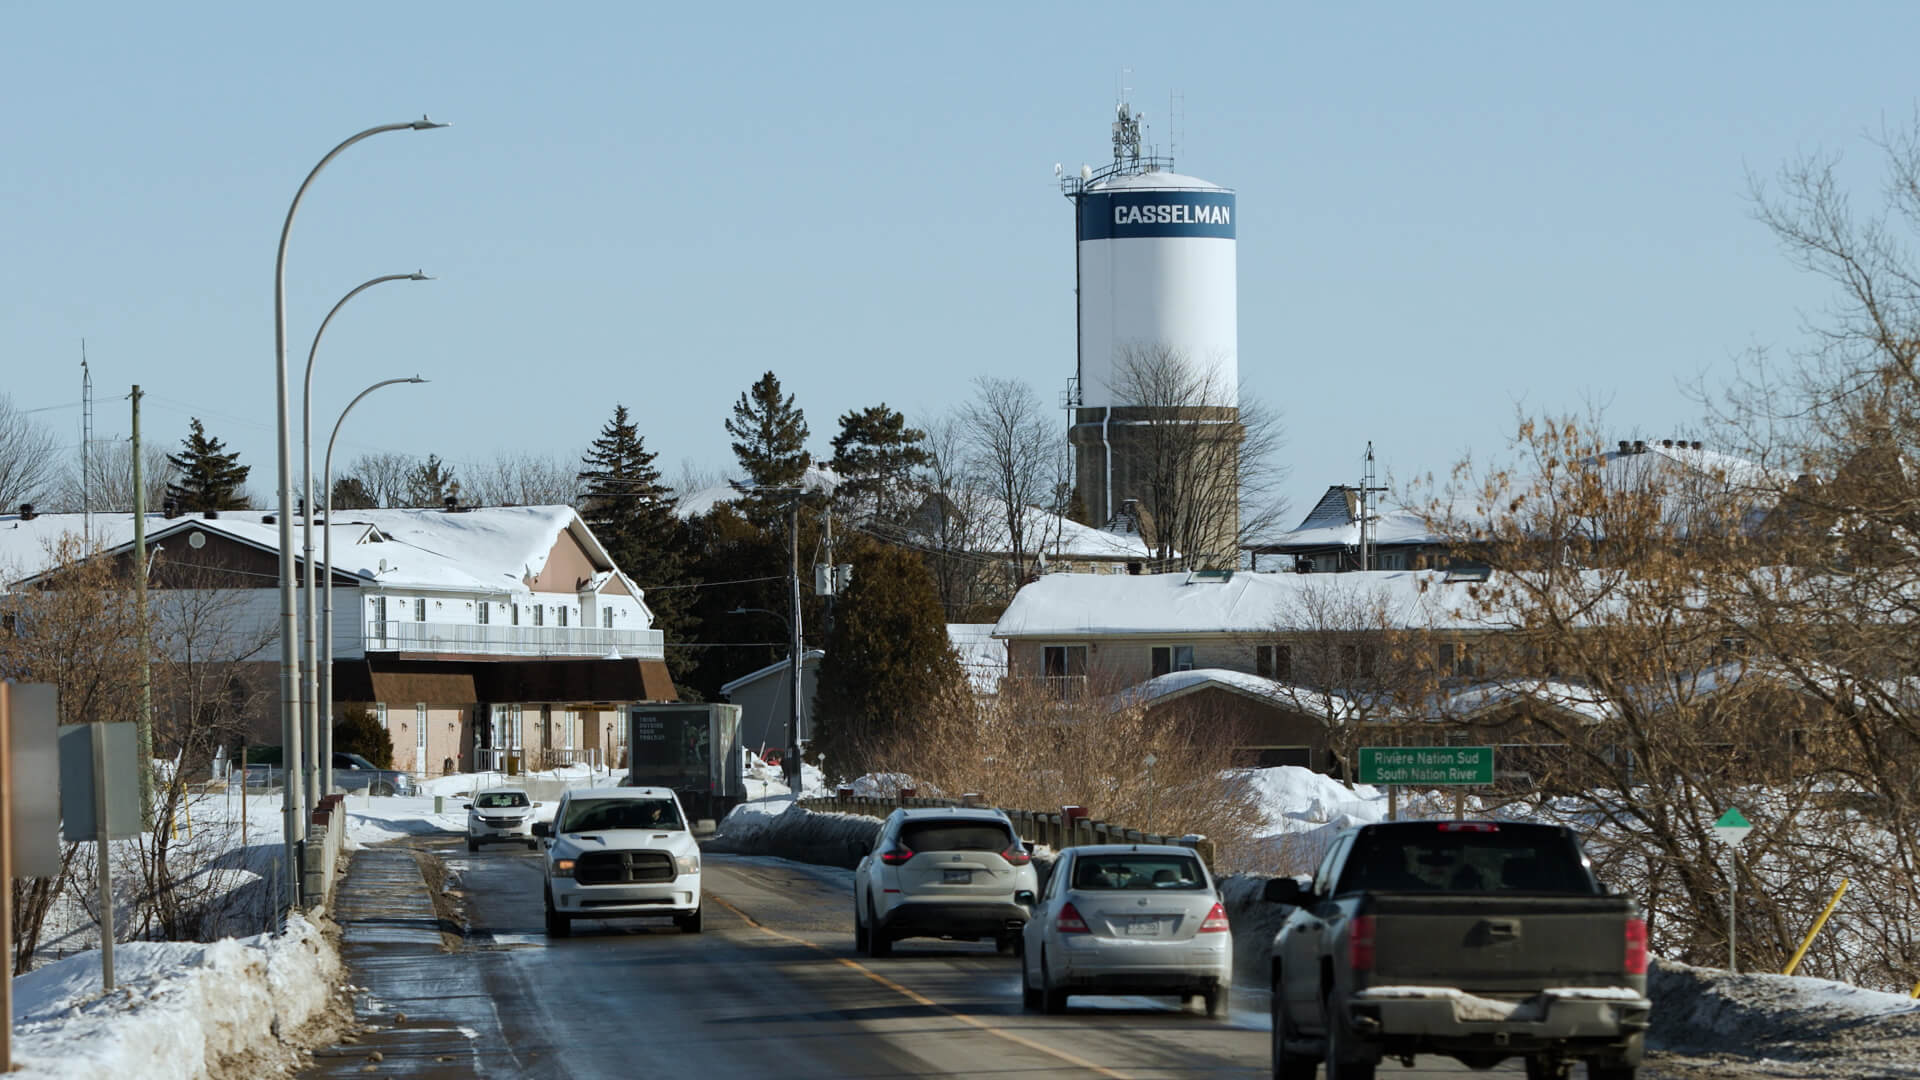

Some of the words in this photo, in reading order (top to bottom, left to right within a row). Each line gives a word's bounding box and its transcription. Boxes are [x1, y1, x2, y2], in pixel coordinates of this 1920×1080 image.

[1114, 204, 1230, 225] CASSELMAN
[1374, 751, 1414, 764] Rivière
[1417, 752, 1454, 764] Nation
[1457, 751, 1479, 764] Sud
[1376, 767, 1408, 780] South
[1411, 767, 1446, 780] Nation
[1449, 767, 1478, 780] River
